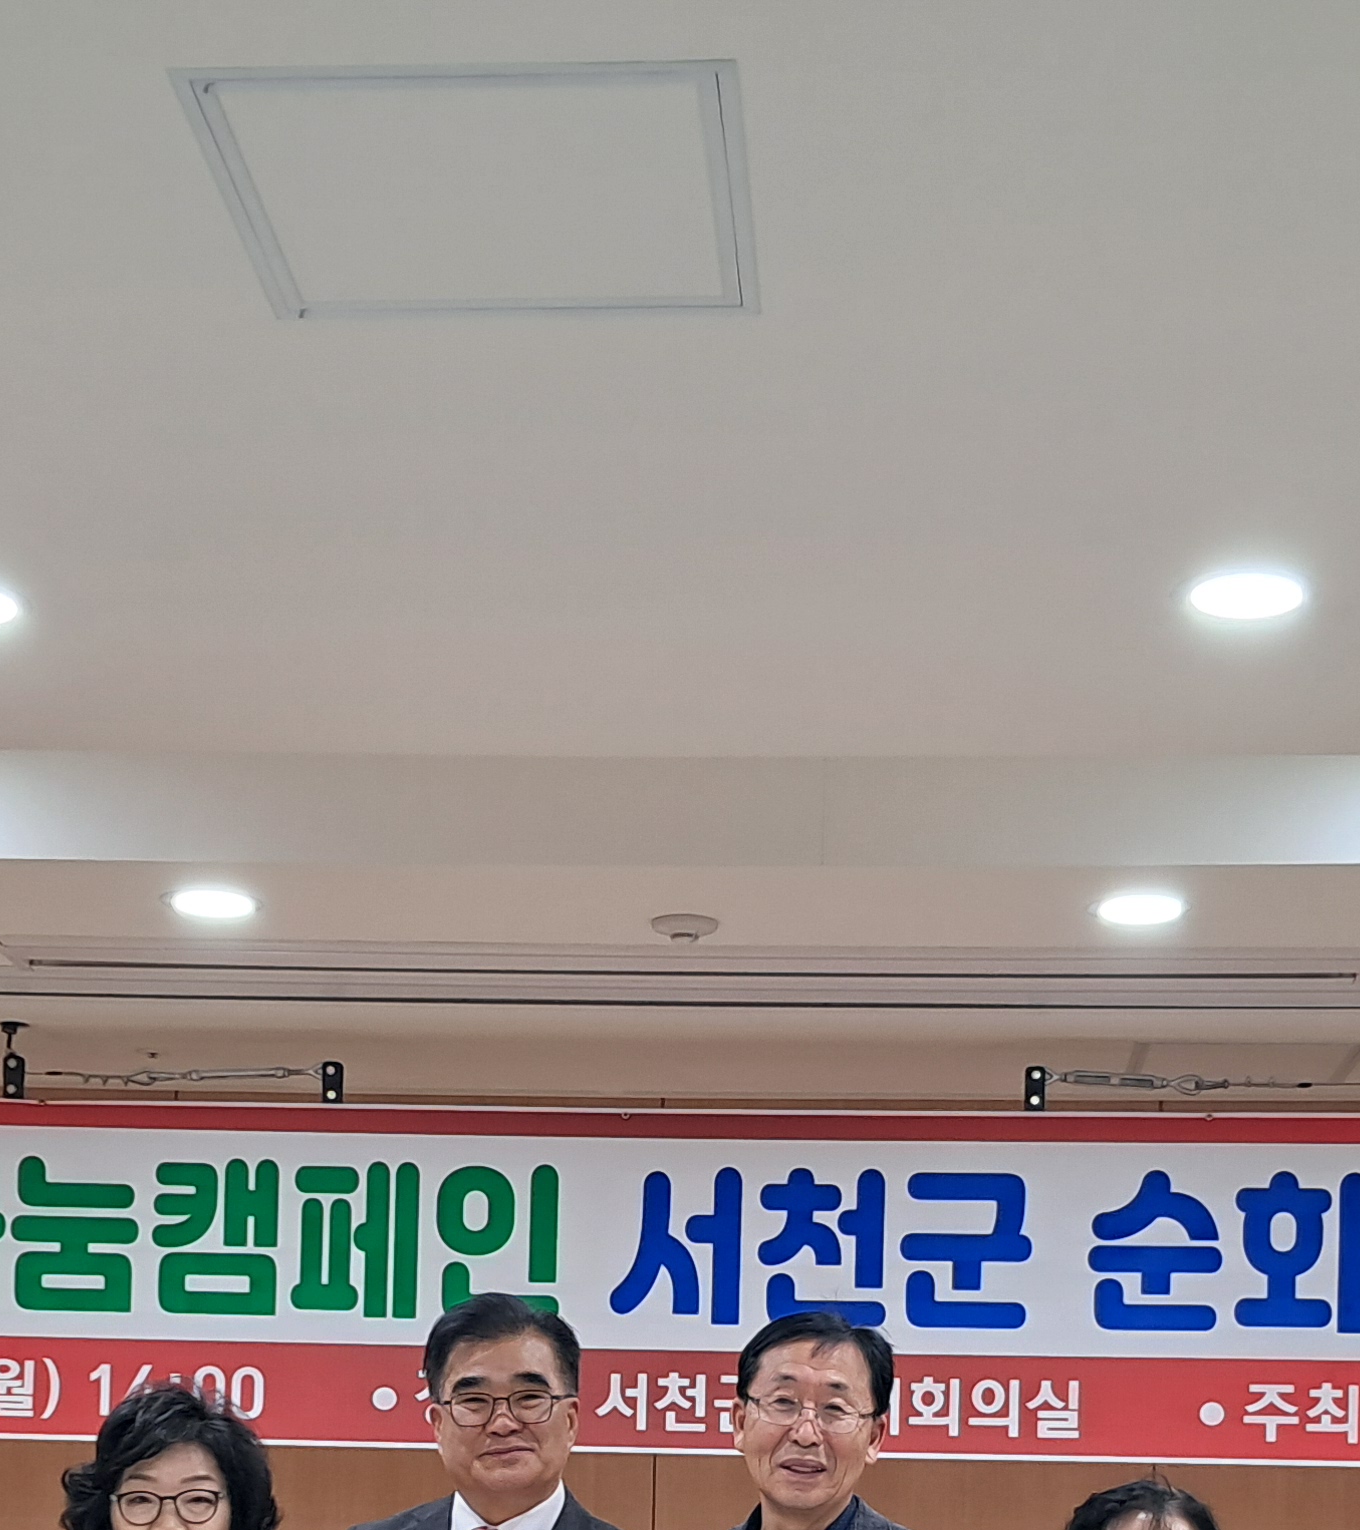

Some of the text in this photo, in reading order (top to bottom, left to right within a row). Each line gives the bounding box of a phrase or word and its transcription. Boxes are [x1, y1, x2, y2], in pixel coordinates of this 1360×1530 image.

[609, 1166, 1032, 1331] 서천군
[887, 1377, 1081, 1439] 회의실
[1242, 1383, 1359, 1445] 주최
